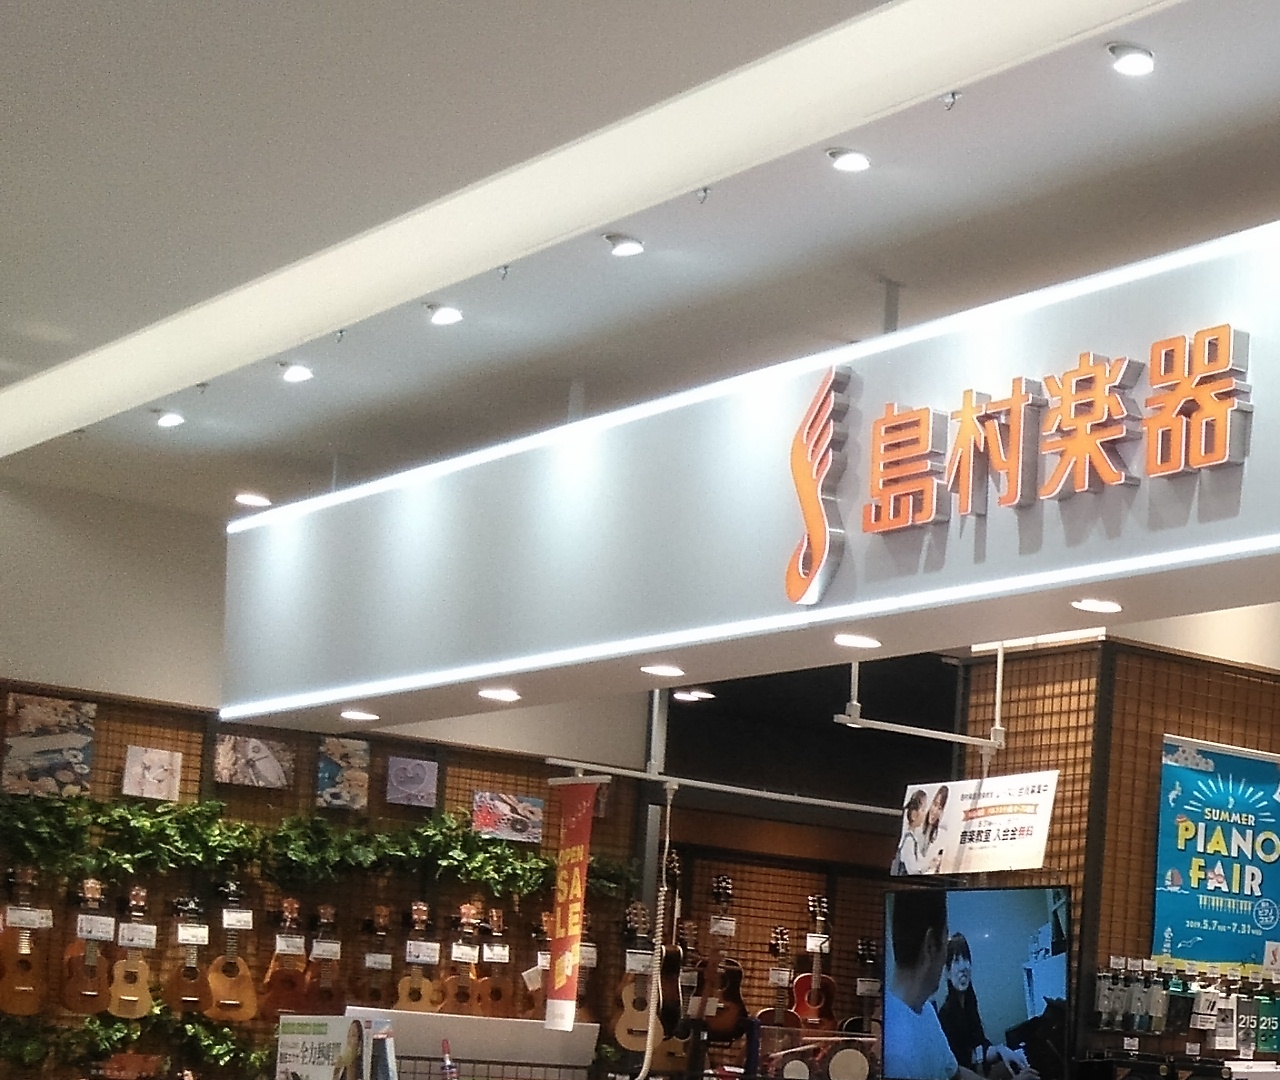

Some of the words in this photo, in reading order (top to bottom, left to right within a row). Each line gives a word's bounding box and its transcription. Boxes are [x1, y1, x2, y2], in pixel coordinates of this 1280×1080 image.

[862, 323, 1240, 534] 島村楽器
[1204, 807, 1256, 827] SUMMER
[559, 845, 584, 863] OPEN
[1190, 857, 1264, 897] FAIR
[1239, 1015, 1257, 1028] 215
[1260, 1017, 1279, 1030] 215
